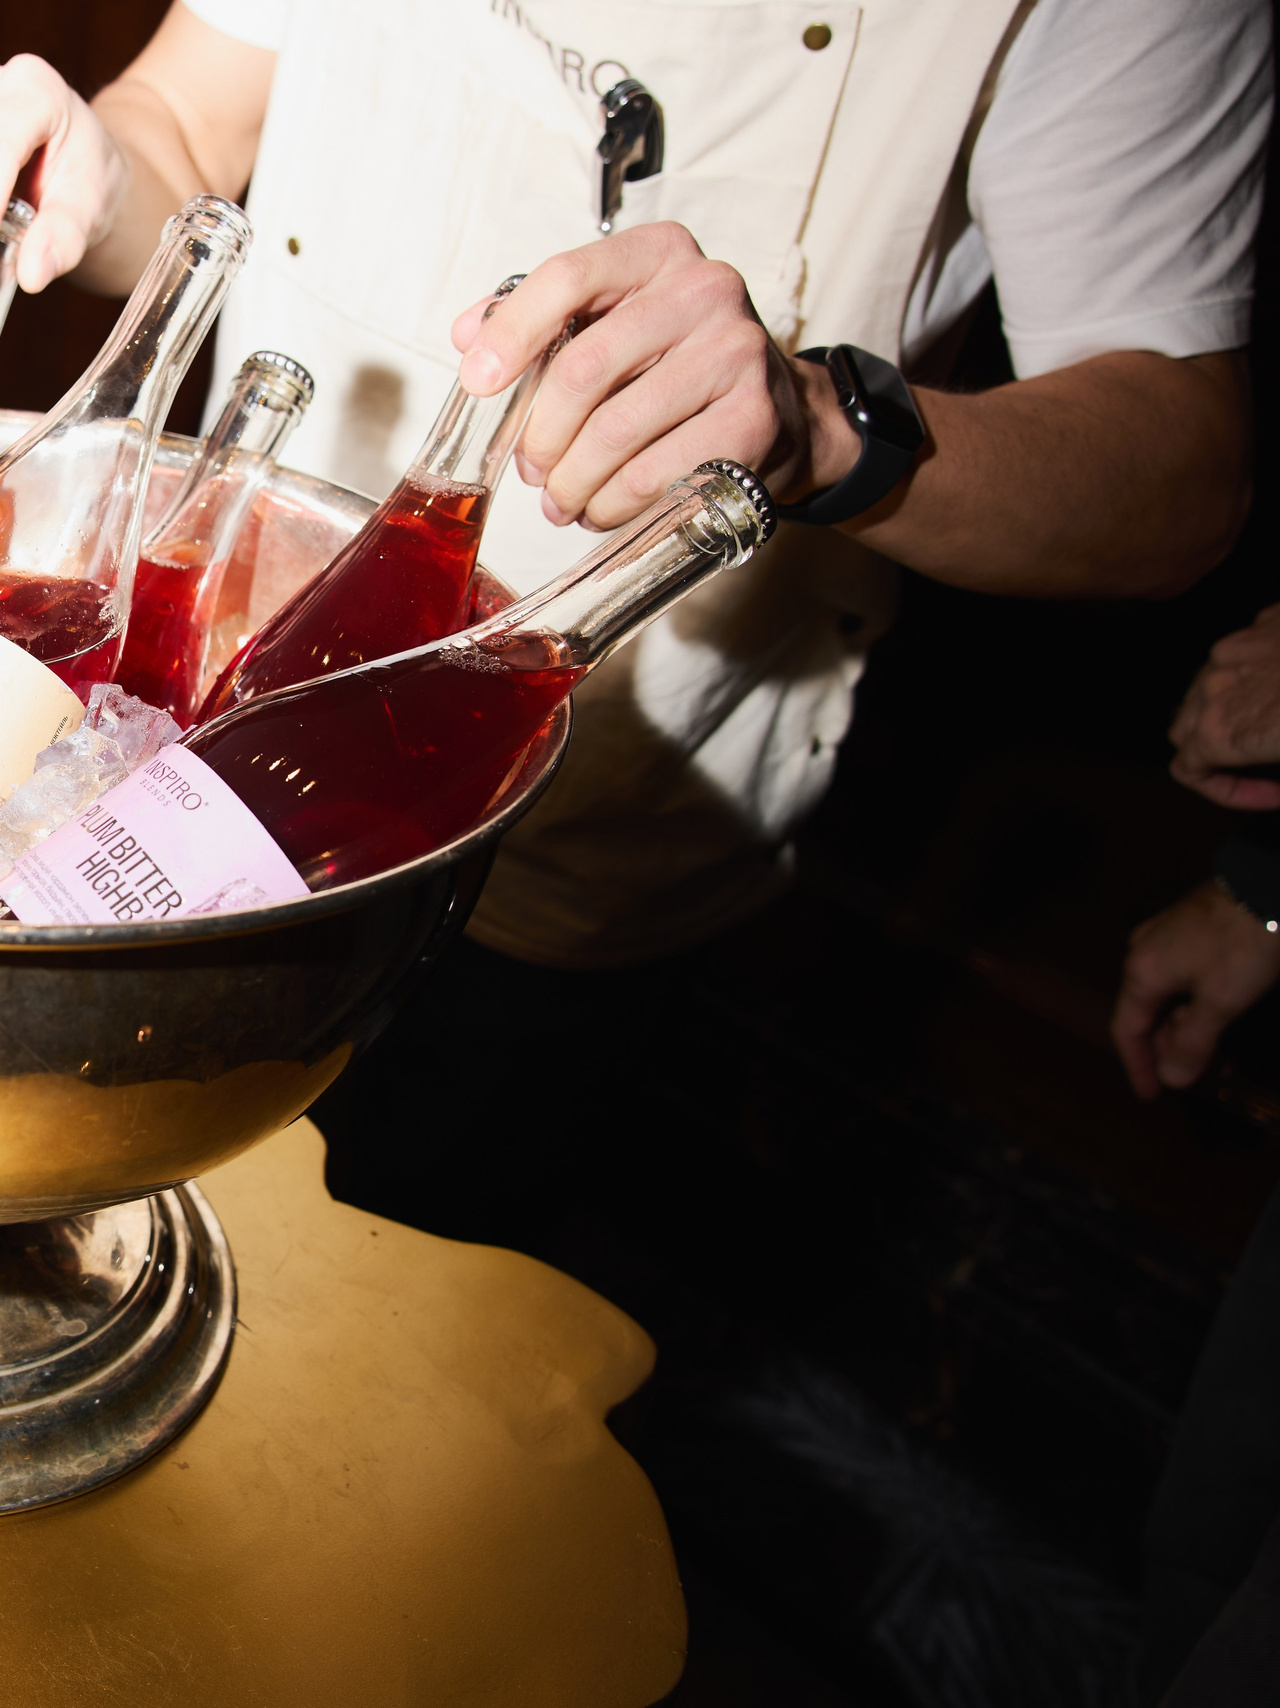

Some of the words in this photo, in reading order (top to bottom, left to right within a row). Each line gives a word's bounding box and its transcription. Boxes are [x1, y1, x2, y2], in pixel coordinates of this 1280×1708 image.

[139, 778, 172, 808] BLENDS
[143, 758, 203, 812] INSPIRO
[76, 804, 125, 847] PLUM
[111, 835, 183, 920] BITTER
[76, 850, 154, 923] HIGHB
